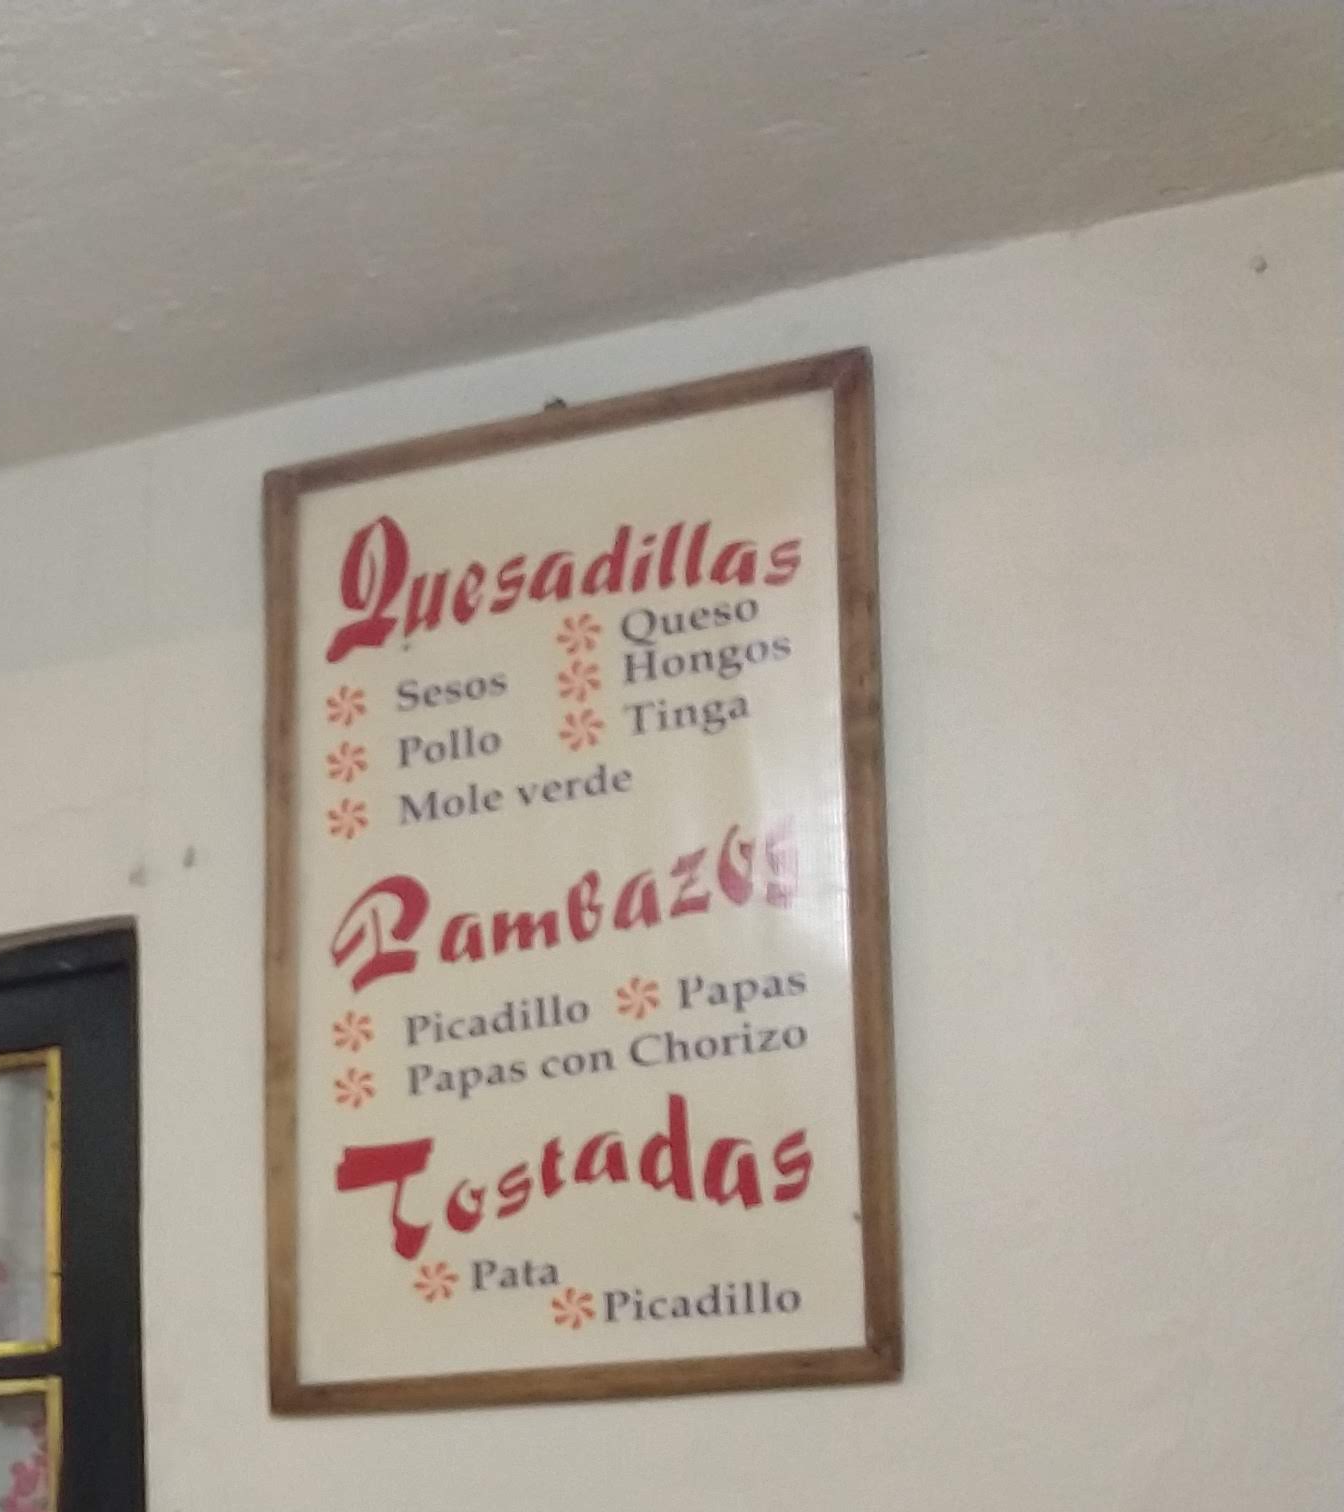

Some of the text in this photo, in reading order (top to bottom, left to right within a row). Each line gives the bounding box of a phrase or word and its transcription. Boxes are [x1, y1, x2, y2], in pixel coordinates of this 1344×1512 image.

[325, 514, 802, 663] Quesadillas
[620, 598, 759, 647] Queso
[623, 633, 792, 685] Hongos
[396, 672, 508, 712] Sesos
[624, 693, 749, 736] Tinga
[397, 726, 503, 768] Pollo
[398, 764, 633, 826] Mole verde
[330, 820, 801, 994] Pambazos
[678, 970, 808, 1013] Papas
[404, 995, 590, 1046] Picadillo
[407, 1023, 809, 1100] Papas con Chorizo
[335, 1093, 813, 1260] Tostadas
[470, 1259, 561, 1292] Pata
[602, 1281, 803, 1323] Picadillo
